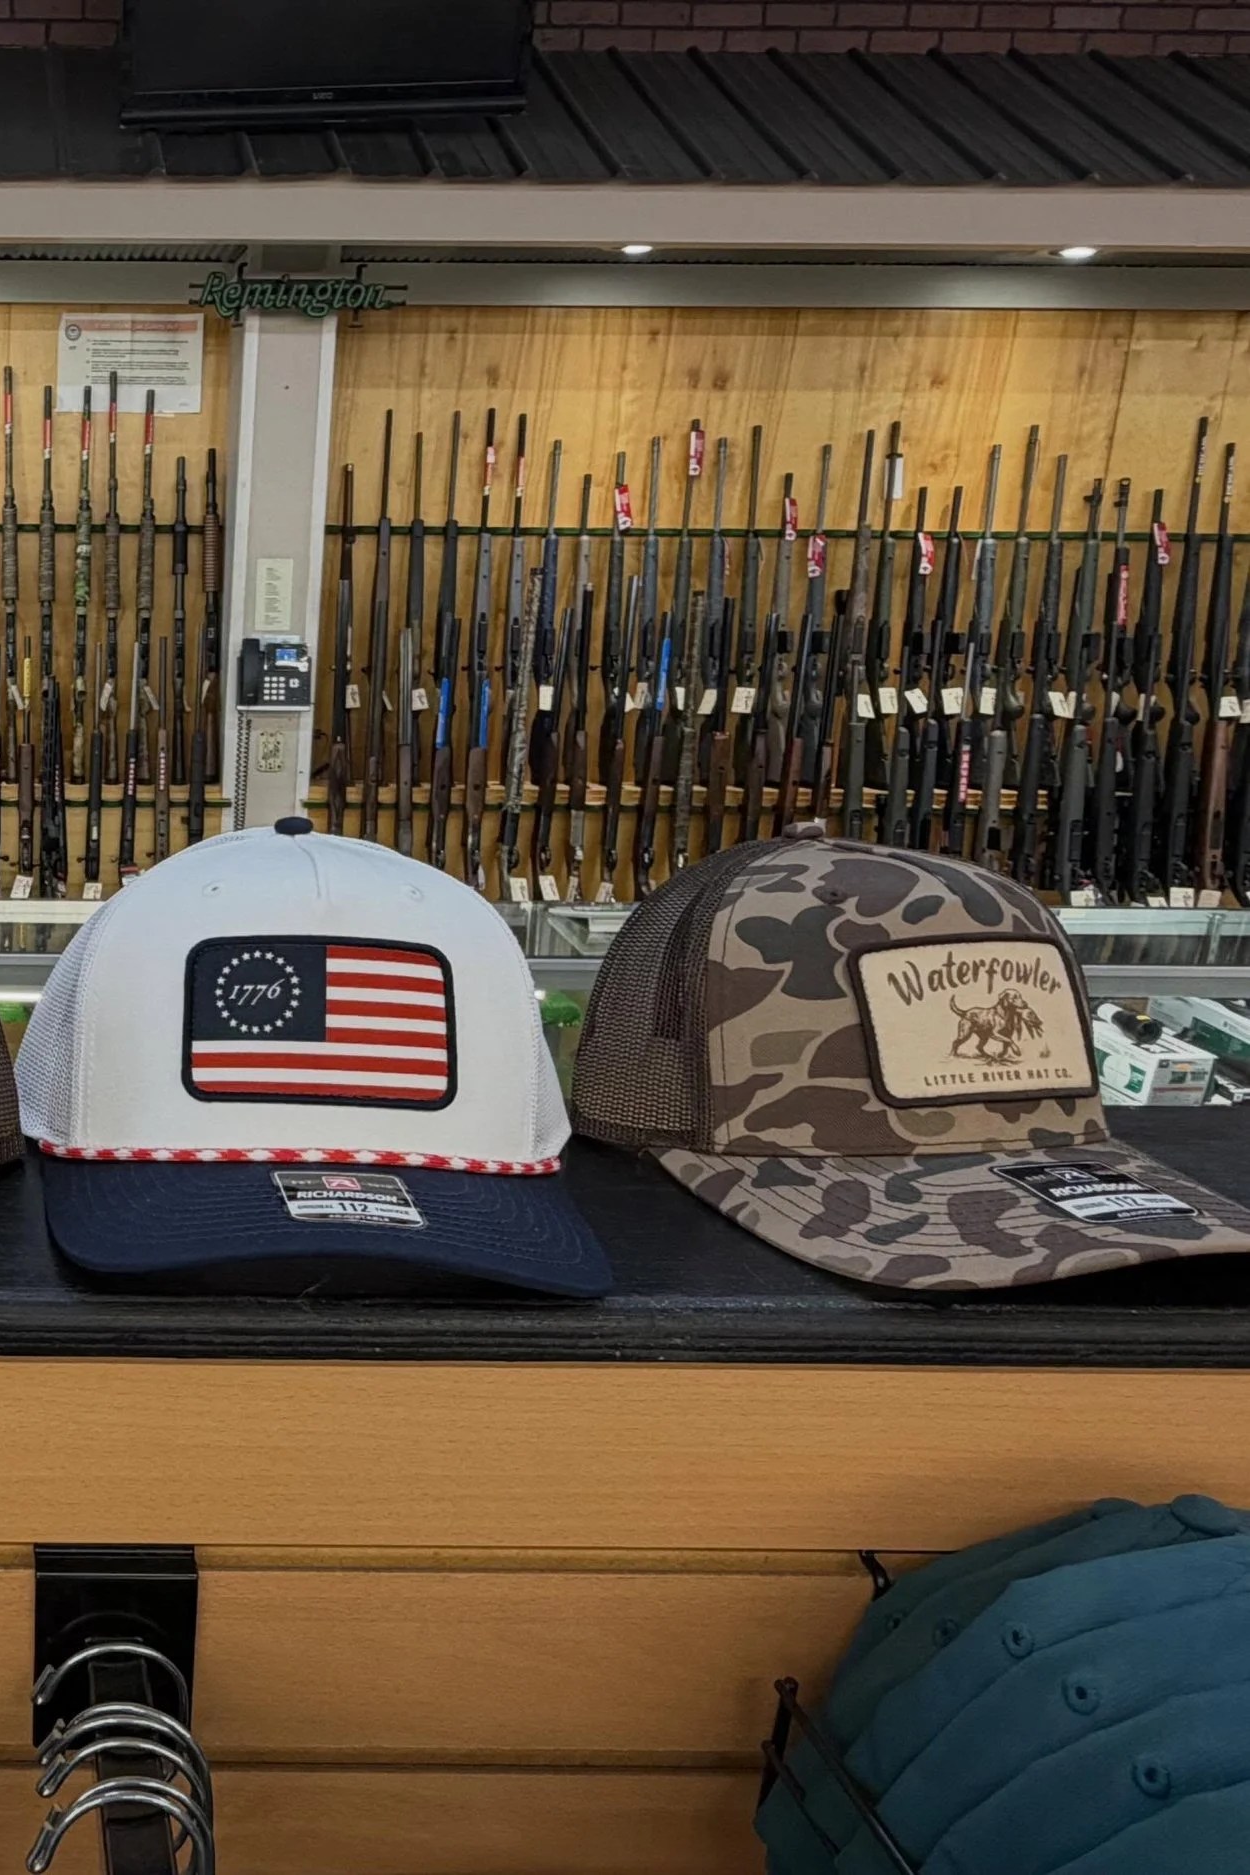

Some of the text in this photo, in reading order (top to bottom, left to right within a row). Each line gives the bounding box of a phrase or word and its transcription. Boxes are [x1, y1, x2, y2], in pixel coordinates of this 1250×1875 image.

[200, 271, 388, 318] Remington
[887, 951, 1062, 1006] Waterfowler
[228, 978, 286, 1006] 1776
[924, 1072, 975, 1087] LITTLE
[982, 1068, 1022, 1083] RIVER
[1028, 1068, 1050, 1080] HAT
[297, 1190, 398, 1203] RICHARDSON
[1105, 1196, 1146, 1208] 112
[338, 1202, 371, 1213] 112
